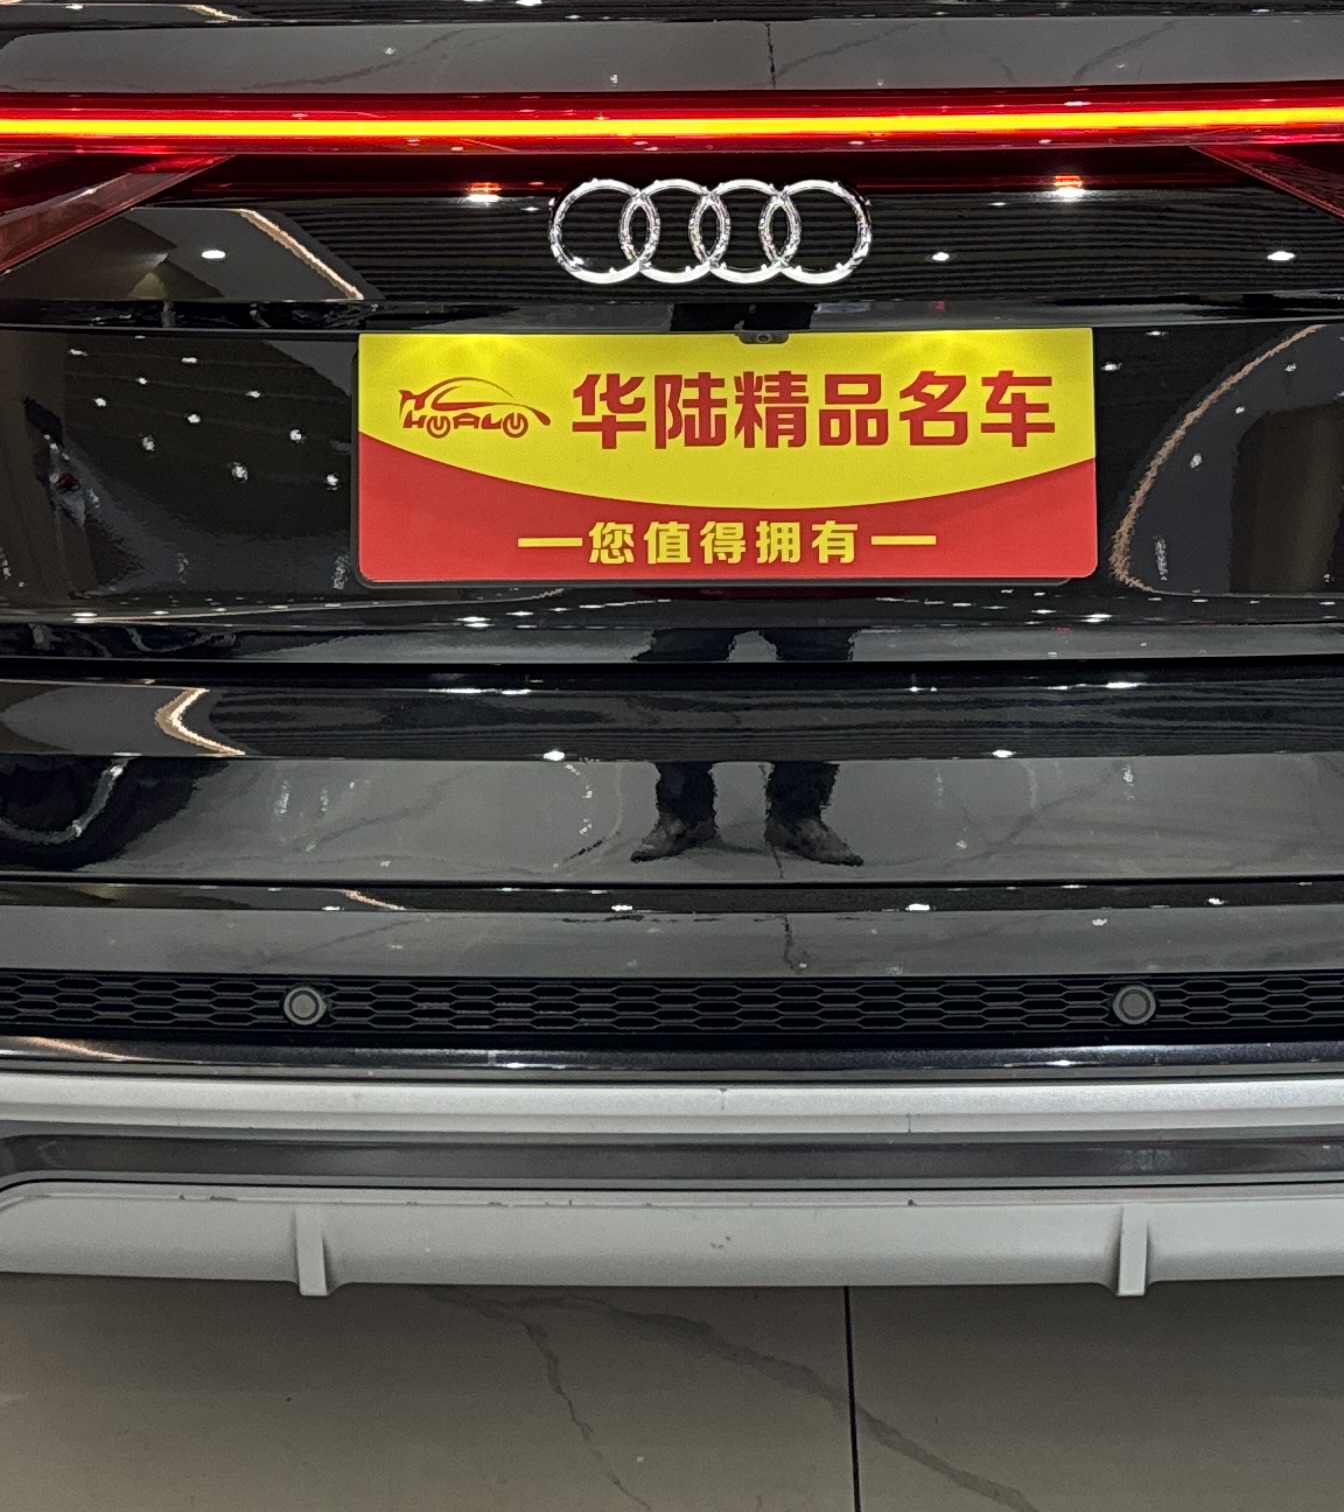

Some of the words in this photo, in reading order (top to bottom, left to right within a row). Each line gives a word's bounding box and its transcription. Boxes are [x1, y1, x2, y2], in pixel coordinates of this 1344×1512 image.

[402, 409, 529, 439] HUALU
[572, 370, 1056, 450] 华陆精品名车
[588, 521, 859, 565] 您值得拥有
